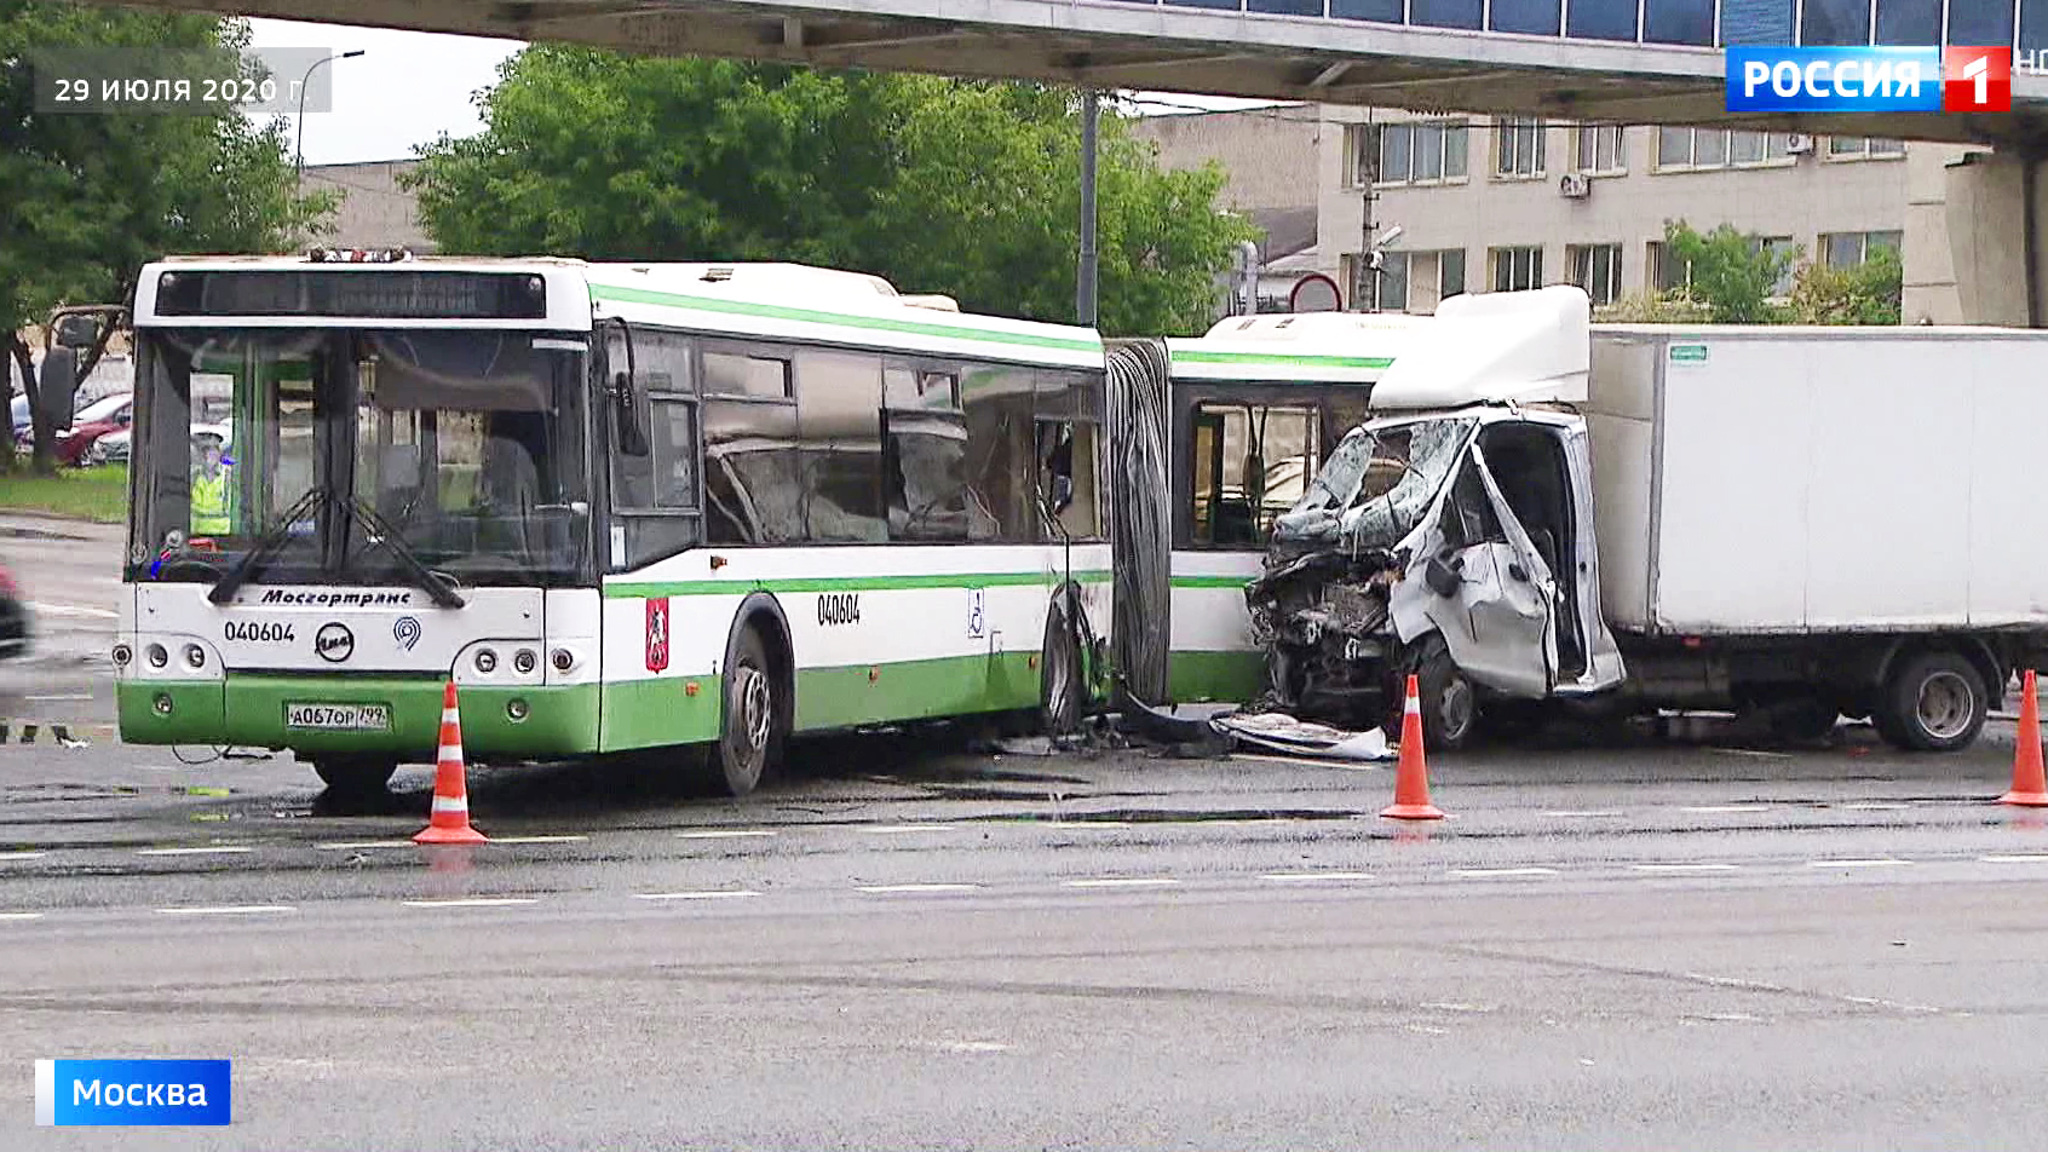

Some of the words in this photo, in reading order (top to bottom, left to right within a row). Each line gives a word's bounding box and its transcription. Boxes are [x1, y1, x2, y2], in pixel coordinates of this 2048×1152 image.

[261, 589, 411, 607] Мосгортранс
[817, 593, 860, 626] 040604
[224, 621, 295, 643] 040604
